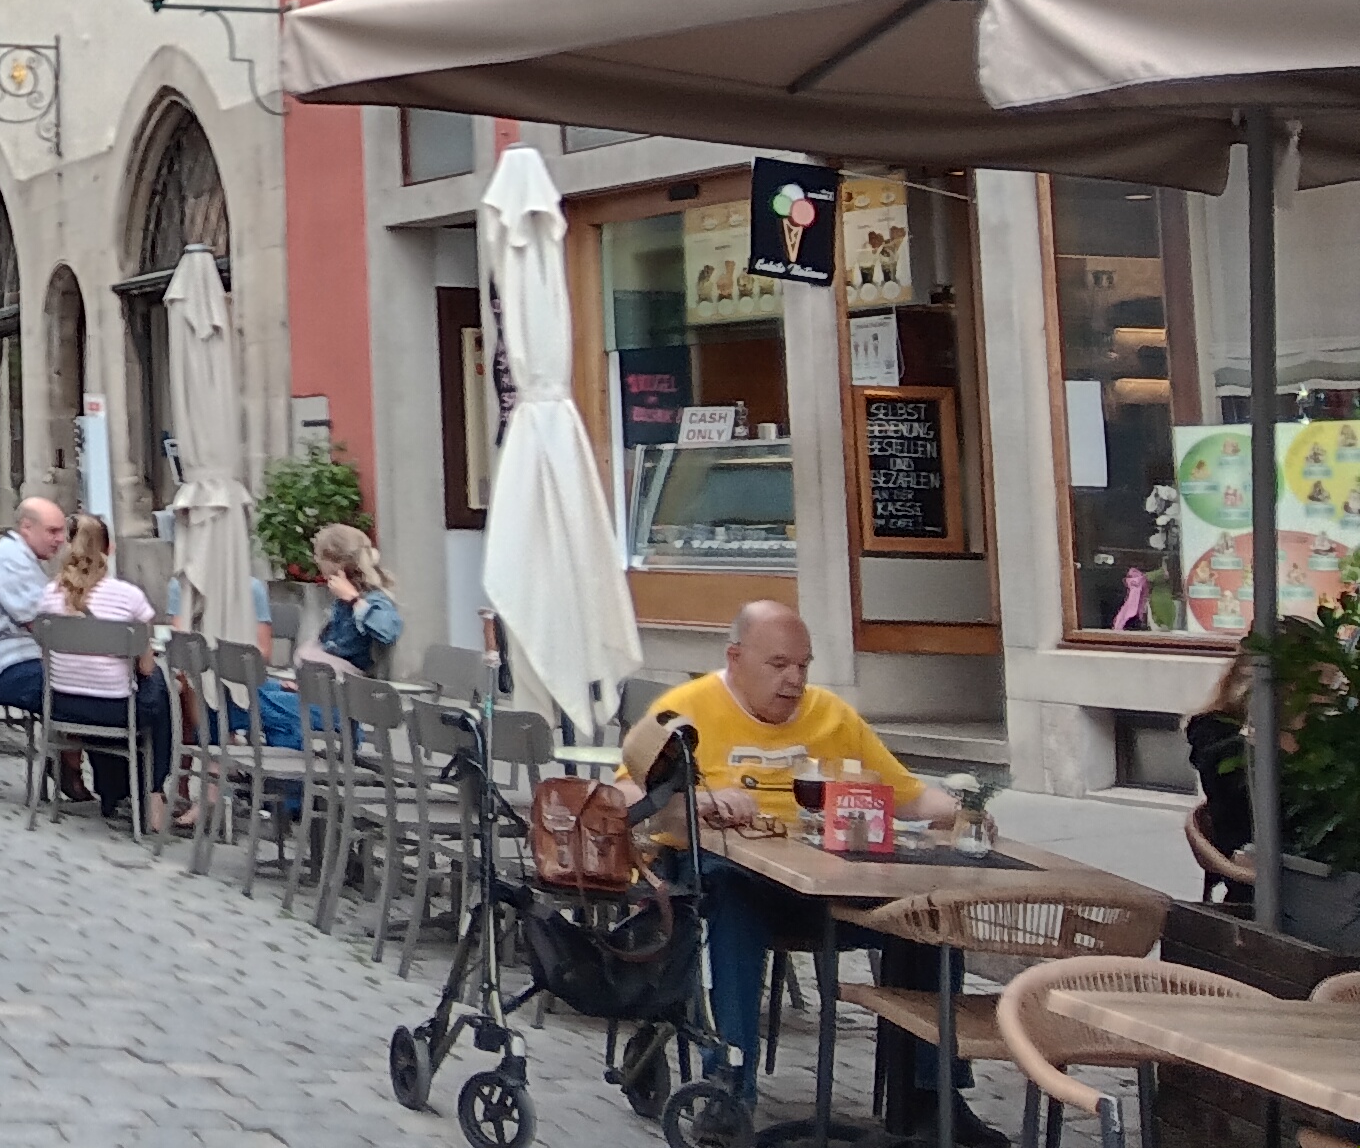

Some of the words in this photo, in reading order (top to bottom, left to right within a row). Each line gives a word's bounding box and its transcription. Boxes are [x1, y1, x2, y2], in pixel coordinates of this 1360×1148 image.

[688, 412, 728, 425] CASH
[870, 402, 927, 421] SELBST
[685, 428, 726, 441] ONLY
[889, 457, 915, 471] UND
[870, 469, 941, 489] BEZAHLEN
[876, 502, 923, 516] KASSE
